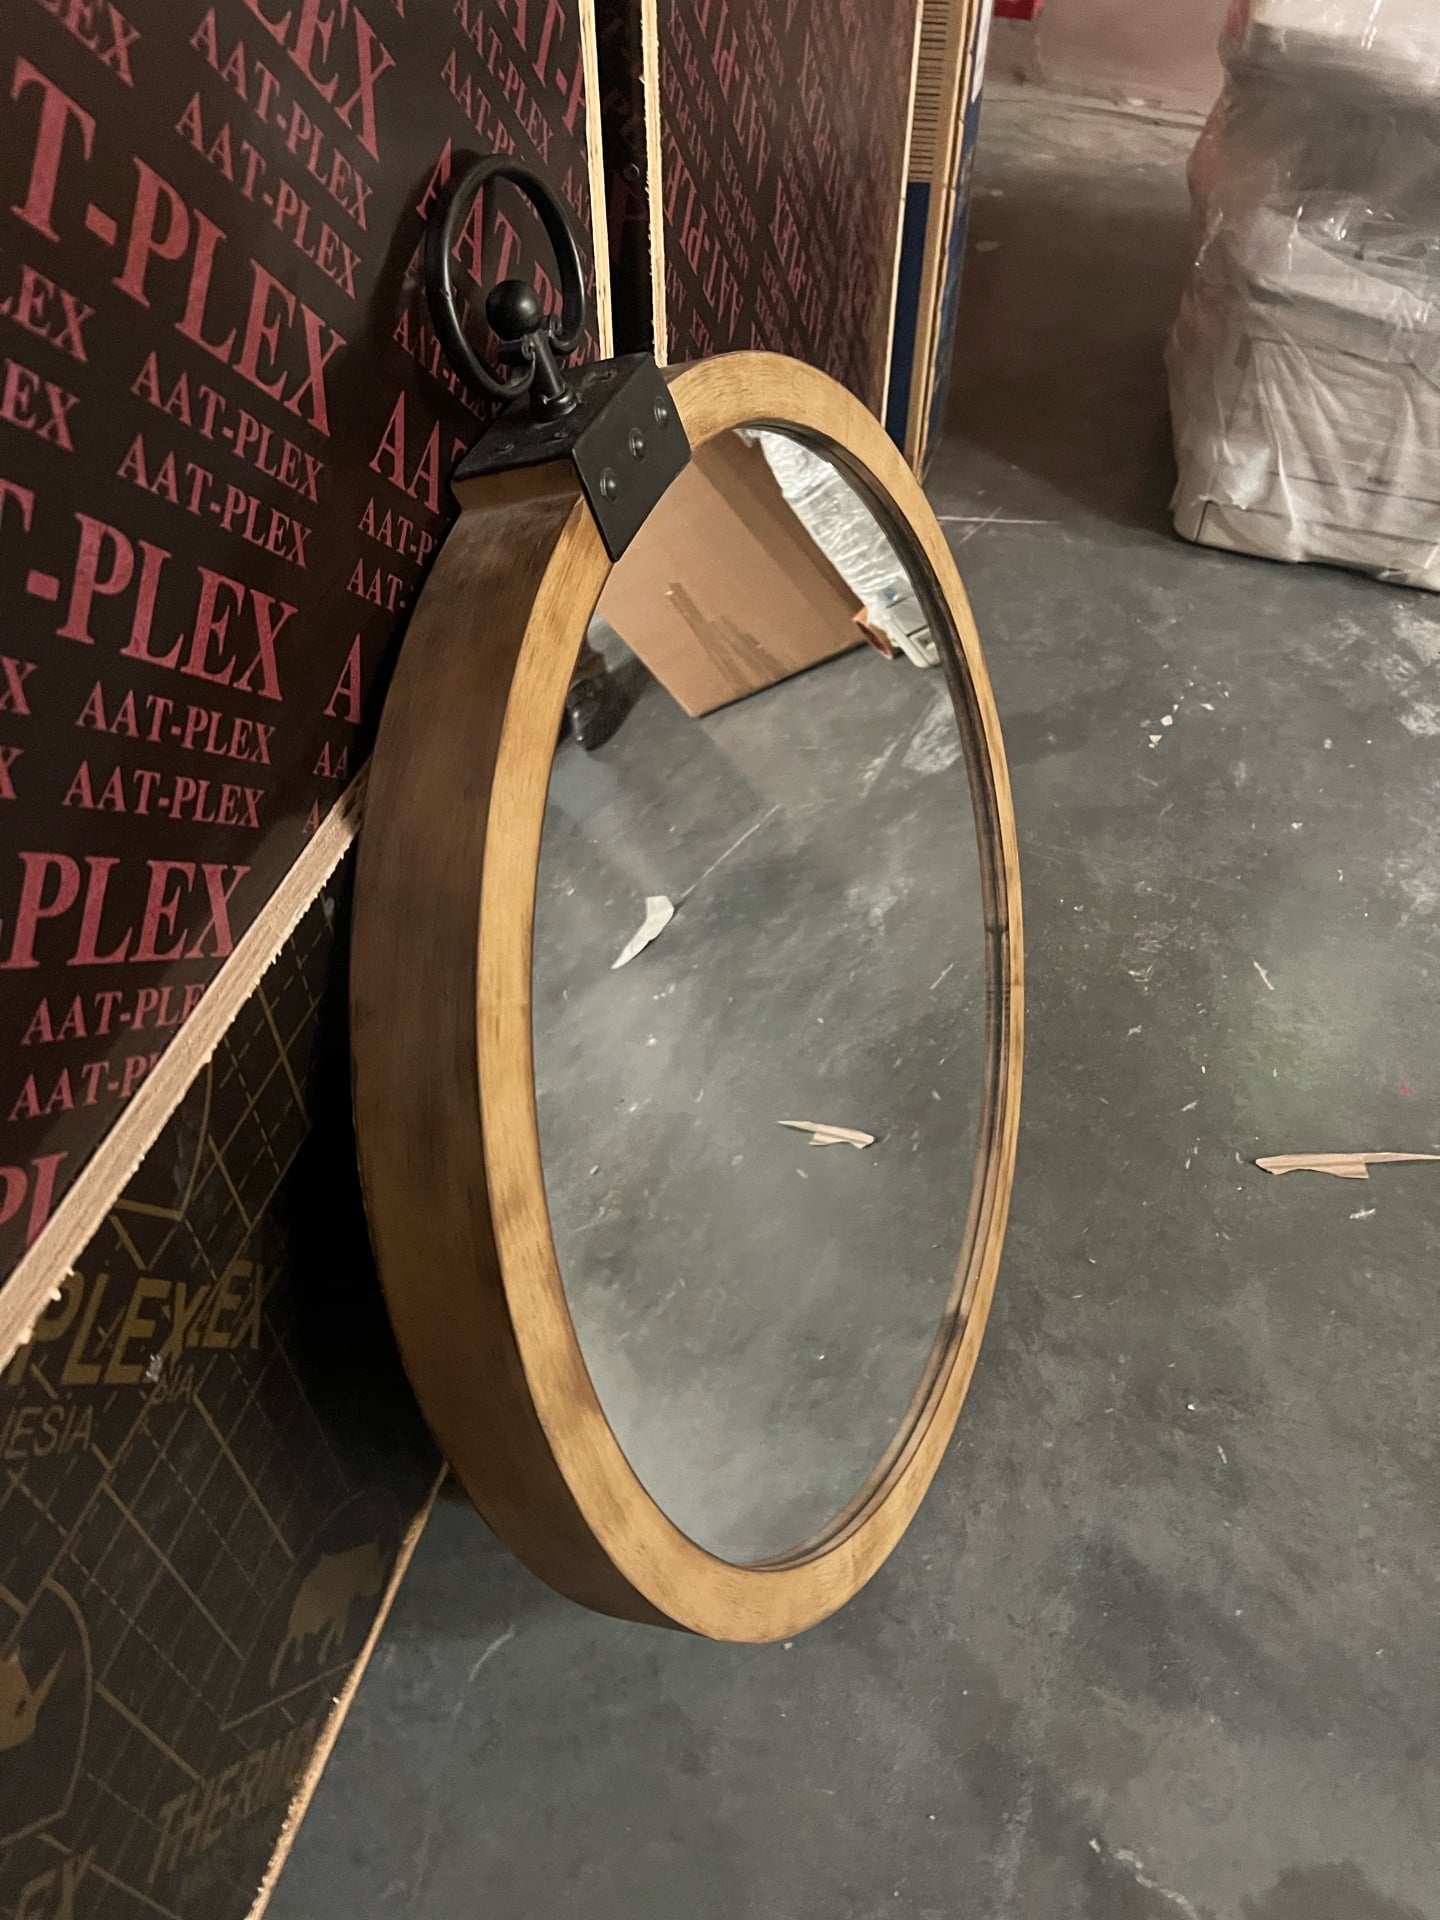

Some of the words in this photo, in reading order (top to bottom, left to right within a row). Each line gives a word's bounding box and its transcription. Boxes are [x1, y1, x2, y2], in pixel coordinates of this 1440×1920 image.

[190, 7, 373, 232] AAT-PLEX
[10, 56, 348, 438] T-PLEX
[175, 91, 361, 300] AAT-PLEX
[0, 263, 96, 363] EX
[131, 351, 324, 503] AAT-PLEX
[116, 433, 312, 568] AAT-PLEX
[75, 681, 277, 766] AAT-PLEX
[61, 759, 265, 829] AAT-PLEX
[0, 1404, 94, 1460] ESIA
